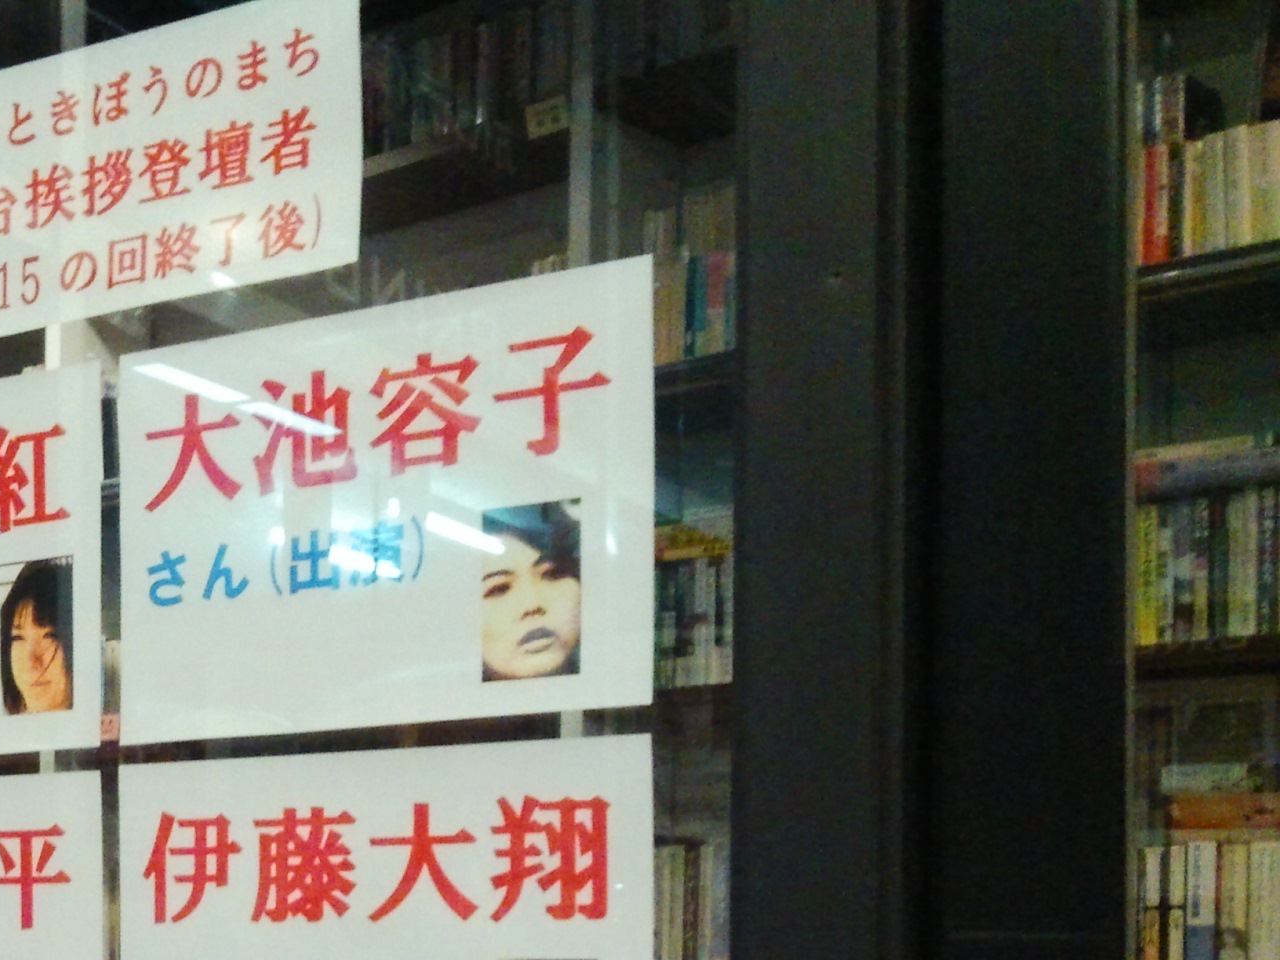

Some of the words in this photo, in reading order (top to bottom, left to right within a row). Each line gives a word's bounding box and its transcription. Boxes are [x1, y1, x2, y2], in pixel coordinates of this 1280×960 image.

[144, 326, 612, 512] 大池容子
[143, 794, 610, 924] 伊藤大翔
